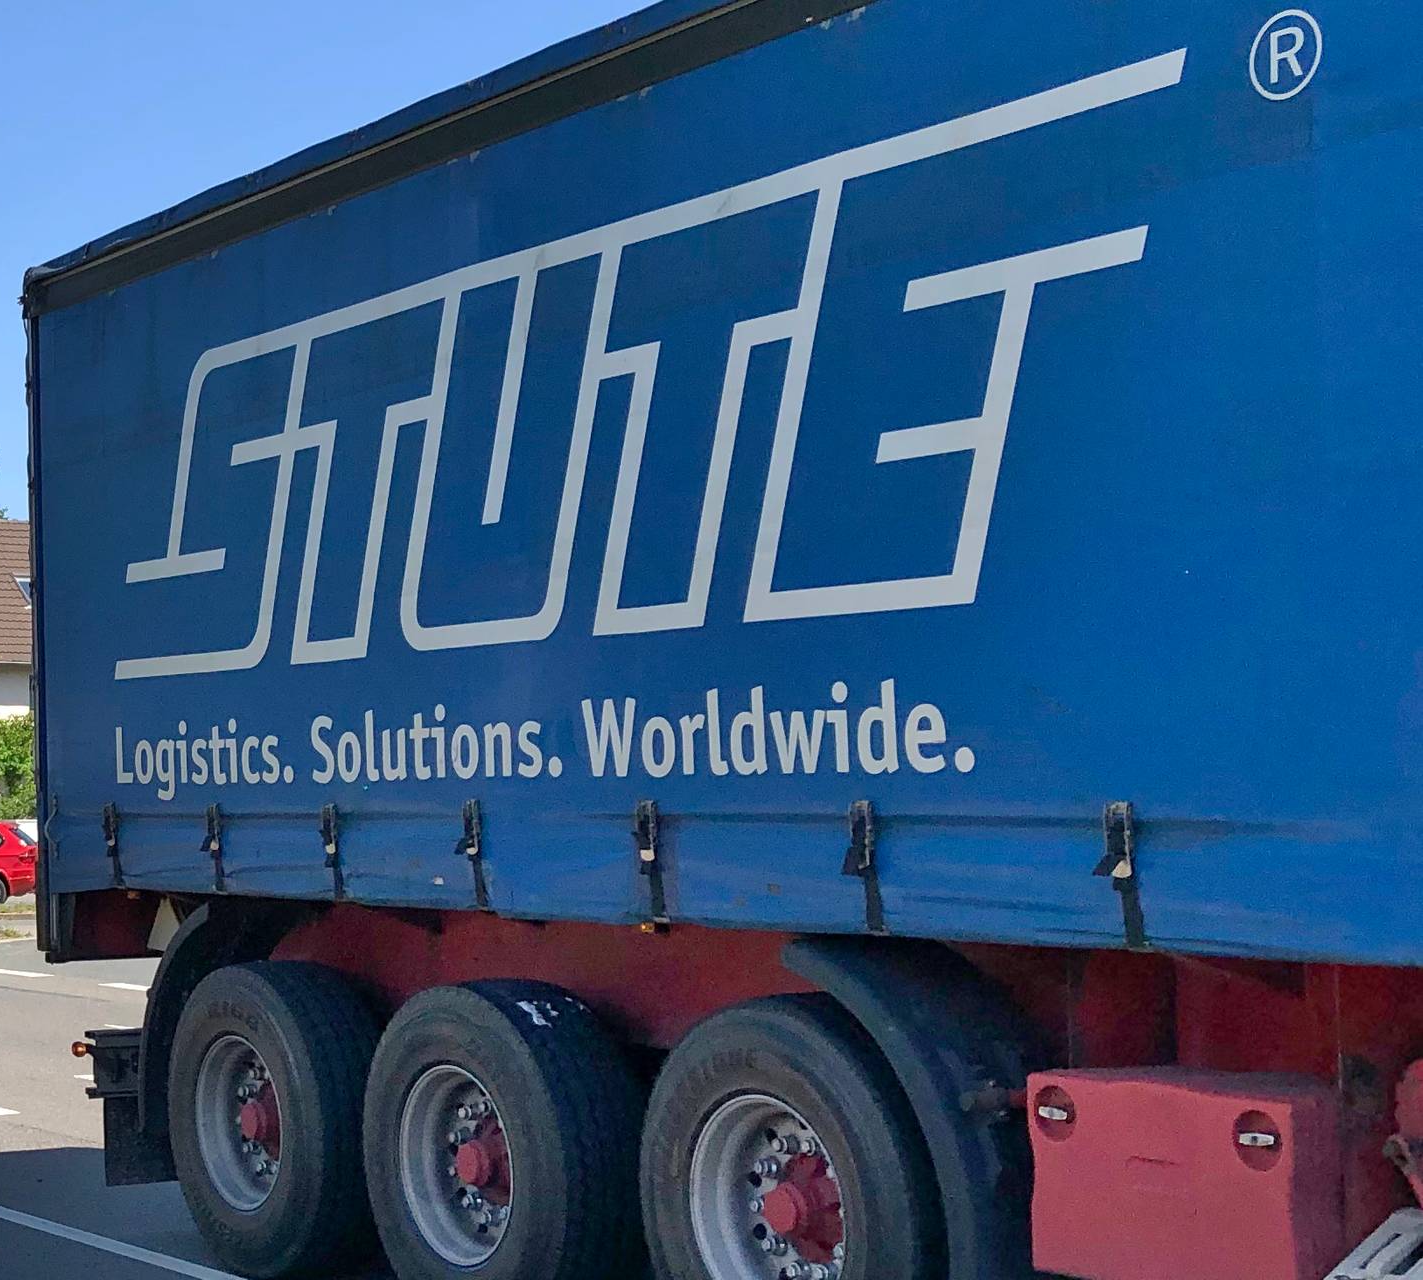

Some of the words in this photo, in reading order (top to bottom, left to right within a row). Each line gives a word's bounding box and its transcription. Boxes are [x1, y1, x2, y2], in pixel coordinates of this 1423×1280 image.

[115, 48, 1187, 680] STUTE
[115, 719, 295, 801] Logistics.
[310, 704, 563, 784] Solutions.
[581, 678, 976, 777] Worldwide.
